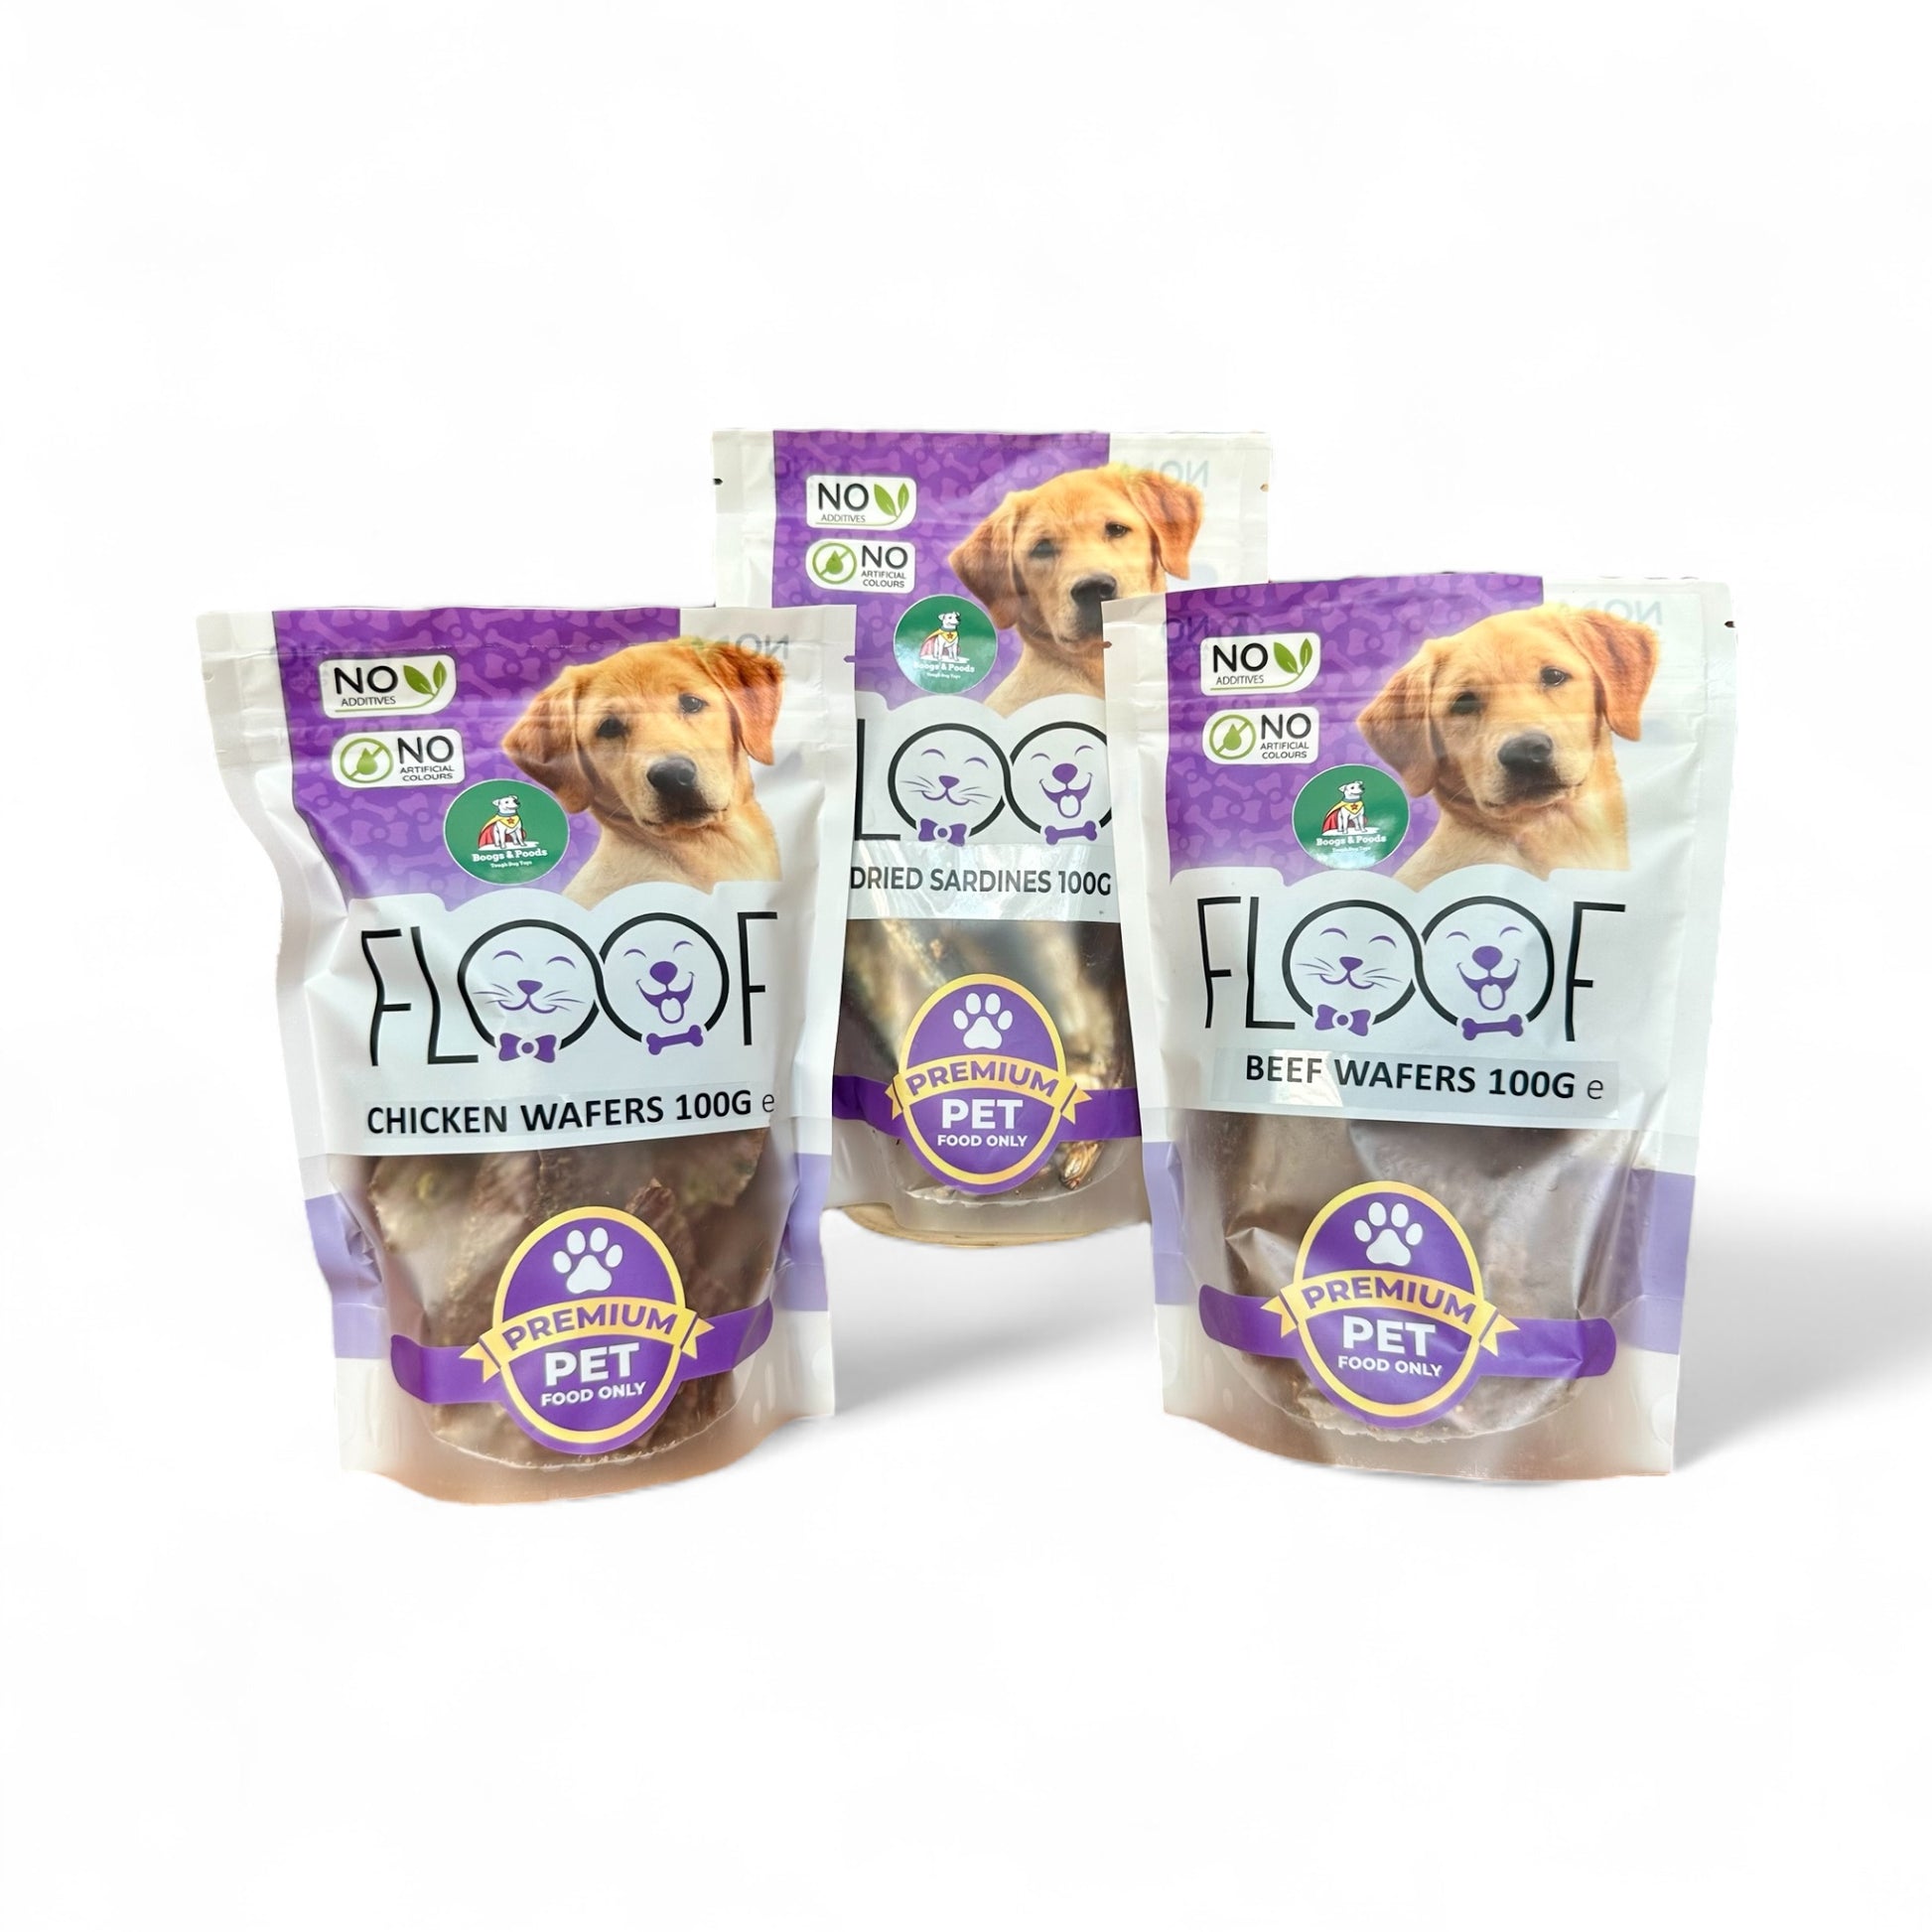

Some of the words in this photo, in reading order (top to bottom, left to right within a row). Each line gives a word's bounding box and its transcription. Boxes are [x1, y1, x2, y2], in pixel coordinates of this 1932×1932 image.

[817, 483, 870, 511] NO
[821, 513, 866, 523] ADDITIVES
[861, 544, 908, 570] NO
[861, 570, 906, 580] ARTIFICIAL
[863, 579, 905, 588] COLOURS
[1213, 642, 1269, 673] NO
[334, 665, 398, 694] NO
[1215, 675, 1264, 685] ADDITIVES
[341, 696, 396, 707] ADDITIVES
[1261, 713, 1311, 740] NO
[397, 735, 454, 764] NO
[1260, 742, 1310, 751] ARTIFICIAL
[1262, 751, 1308, 759] COLOURS
[399, 765, 455, 774] ARTIFICIAL
[855, 719, 1112, 841] LOO
[1347, 835, 1355, 844] &
[1356, 833, 1387, 844] Poods
[472, 853, 505, 863] Boogs
[505, 851, 514, 860] &
[514, 848, 548, 859] Poods
[851, 867, 923, 890] DRIED
[930, 869, 1051, 894] SARDINES
[1058, 871, 1111, 896] 100G
[1196, 895, 1626, 1041] FLOOF
[360, 911, 778, 1066] FLOOF
[904, 1060, 1059, 1098] PREMIUM
[1246, 1054, 1322, 1083] BEEF
[1334, 1058, 1476, 1093] WAFERS
[1489, 1068, 1575, 1099] 100G
[367, 1106, 507, 1135] CHICKEN
[521, 1095, 664, 1131] WAFERS
[676, 1089, 752, 1120] 100G
[942, 1098, 1024, 1129] PET
[937, 1134, 983, 1147] FOOD
[986, 1135, 1029, 1147] ONLY
[1301, 1277, 1476, 1324] PREMIUM
[501, 1304, 678, 1351] PREMIUM
[1343, 1314, 1436, 1357] PET
[545, 1342, 639, 1387] PET
[1337, 1355, 1390, 1372] FOOD
[1394, 1360, 1443, 1377] ONLY
[540, 1388, 595, 1407] FOOD
[598, 1381, 647, 1399] ONLY
